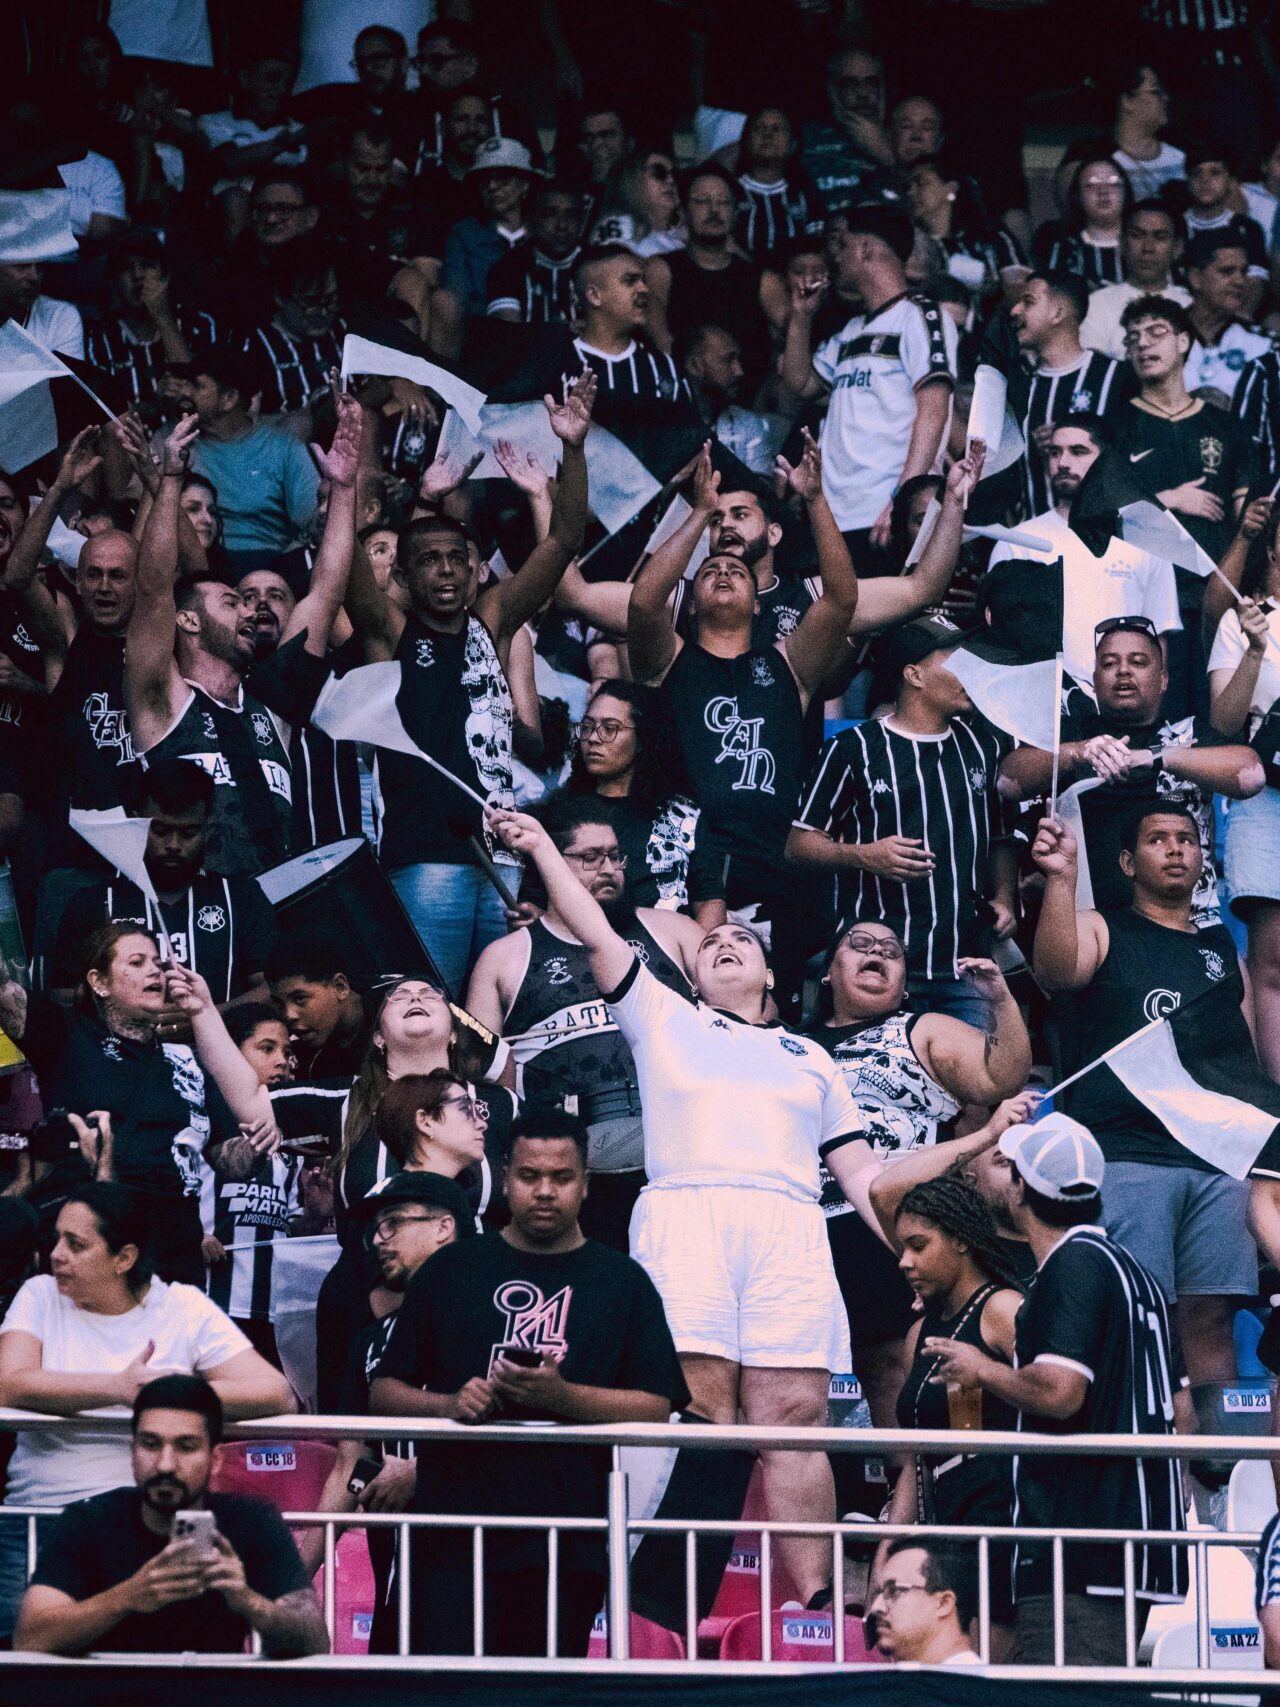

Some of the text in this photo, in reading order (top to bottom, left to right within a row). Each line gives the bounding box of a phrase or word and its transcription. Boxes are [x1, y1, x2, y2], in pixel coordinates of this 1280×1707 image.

[156, 931, 189, 963] 13
[221, 1182, 279, 1201] PARI
[228, 1197, 288, 1220] MATC
[1241, 1394, 1268, 1407] DD 23
[265, 1453, 294, 1466] CC 18
[801, 1625, 832, 1640] AA 20
[1231, 1632, 1259, 1647] AA 22
